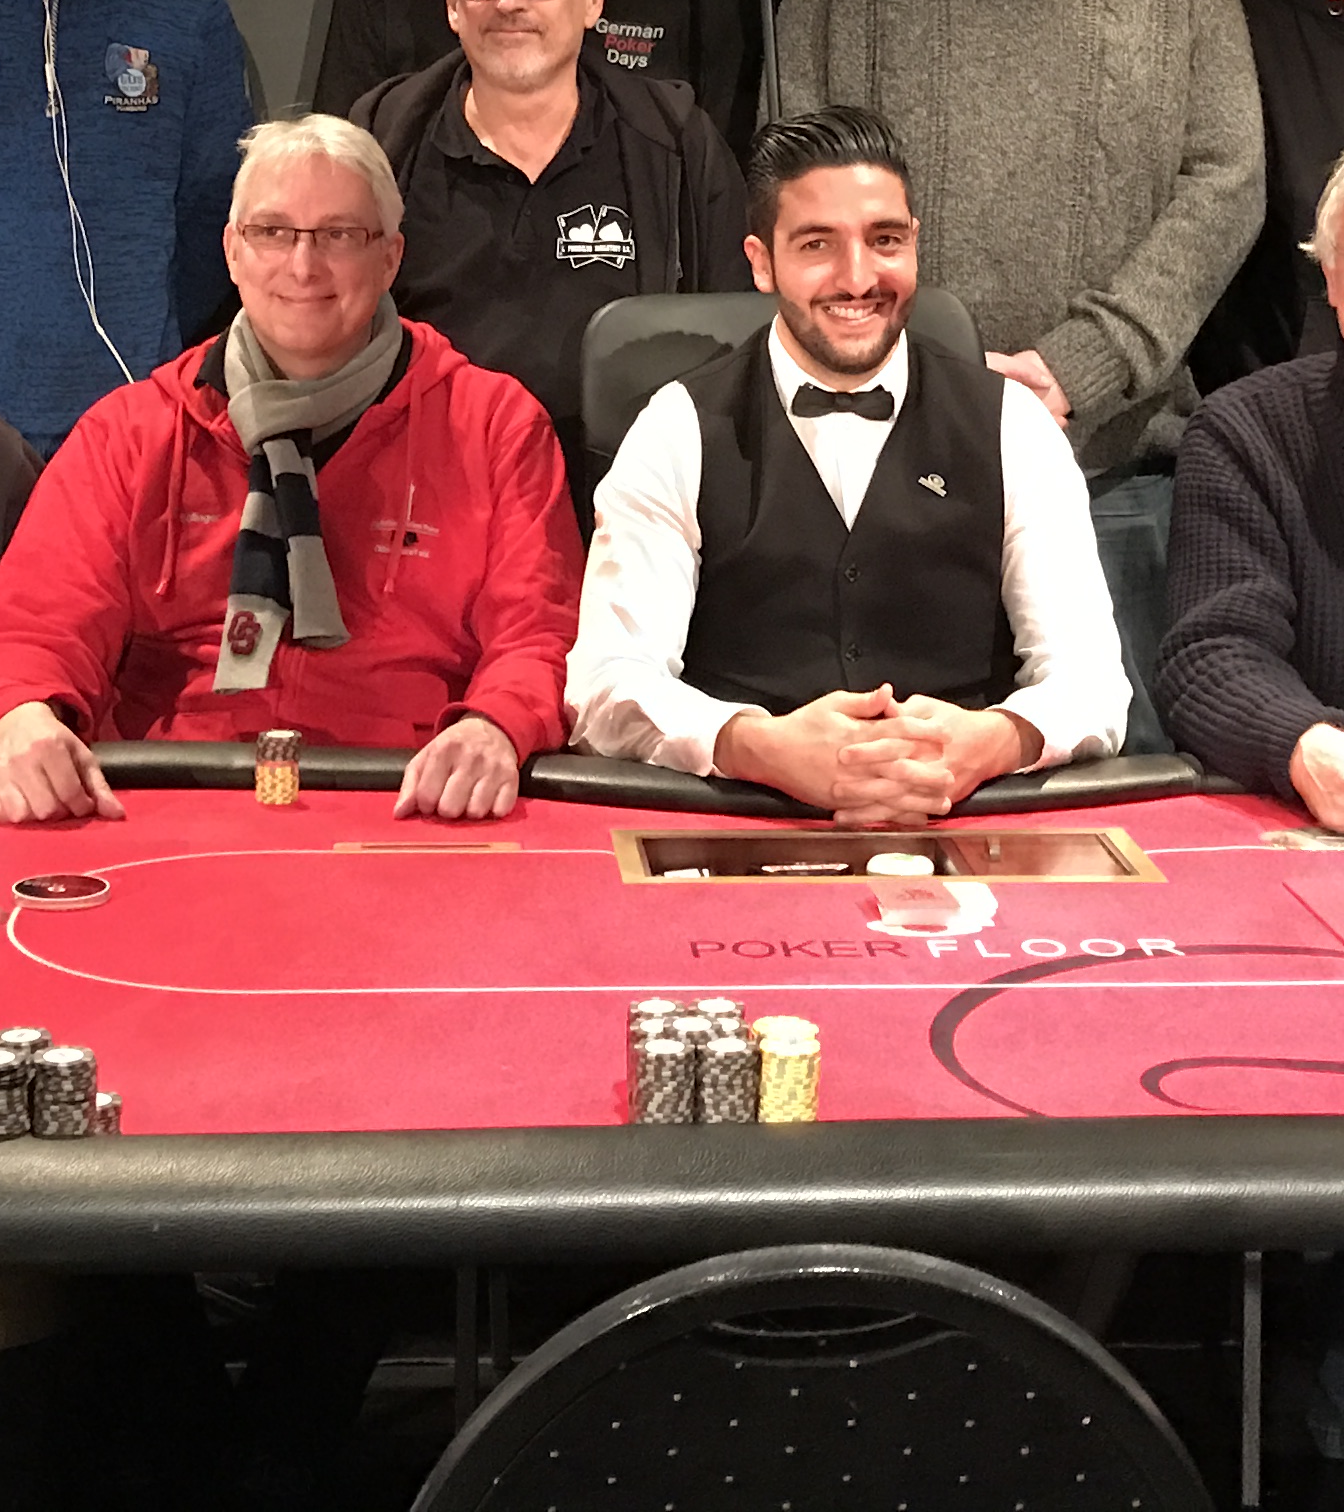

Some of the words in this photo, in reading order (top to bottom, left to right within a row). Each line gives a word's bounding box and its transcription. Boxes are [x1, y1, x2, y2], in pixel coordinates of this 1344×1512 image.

[595, 18, 665, 39] German
[604, 34, 656, 53] Poker
[607, 48, 648, 69] Days
[689, 939, 904, 959] POKER
[925, 938, 1186, 958] FLOOR
